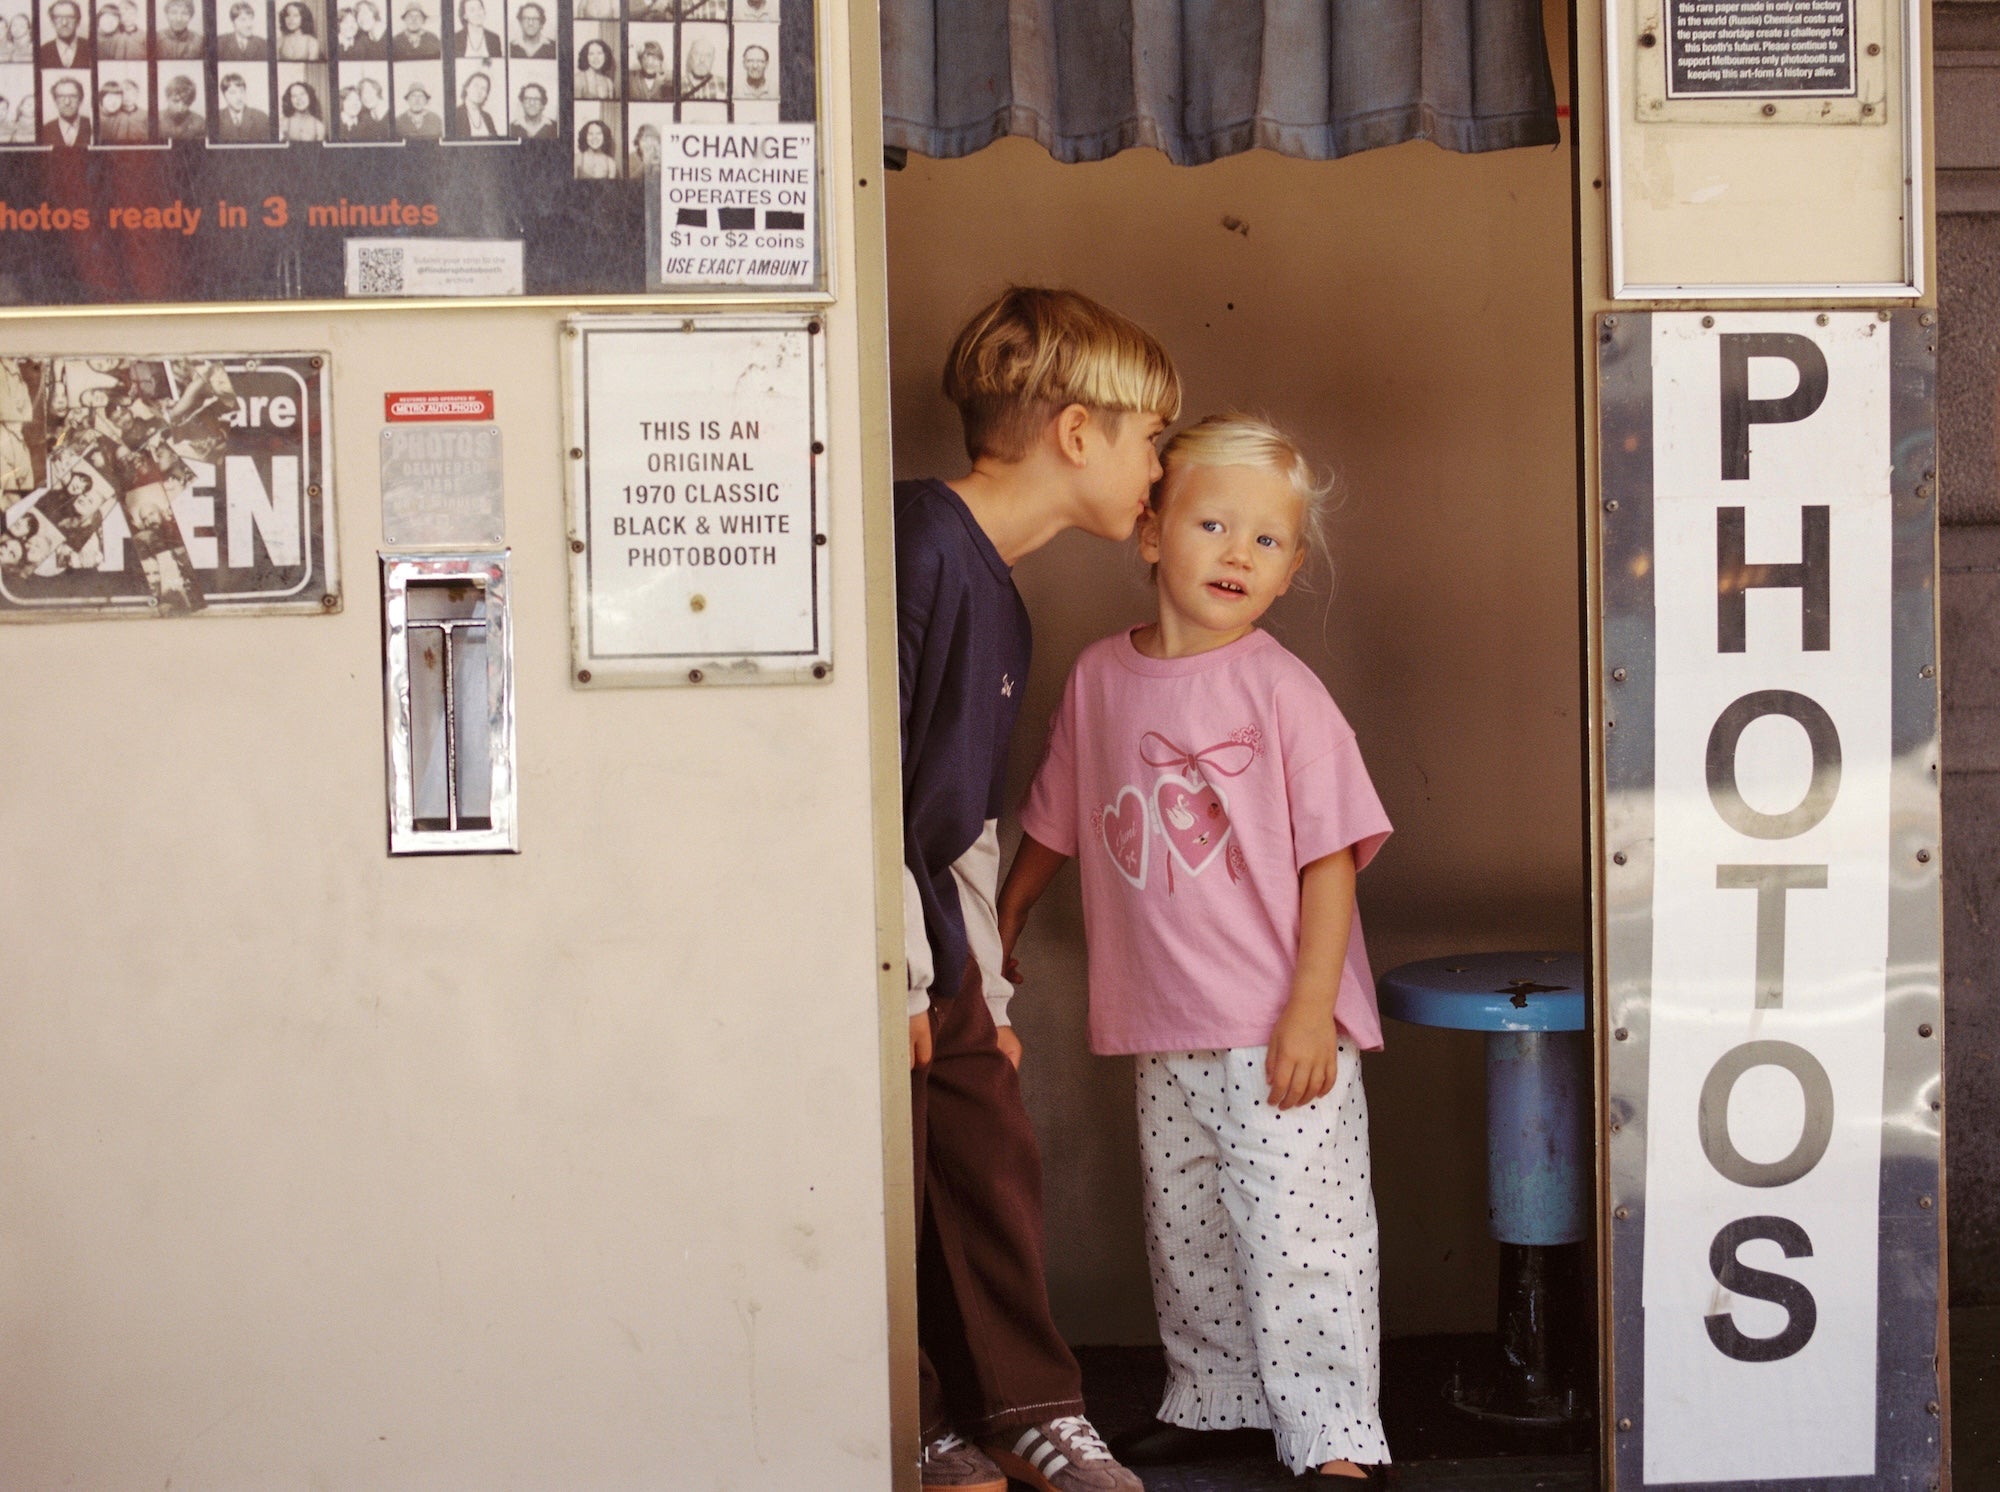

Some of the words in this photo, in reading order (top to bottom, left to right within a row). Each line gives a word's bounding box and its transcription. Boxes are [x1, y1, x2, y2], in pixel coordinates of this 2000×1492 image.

[1679, 2, 1695, 13] this
[1696, 4, 1713, 12] rare
[1715, 3, 1739, 14] paper
[1741, 2, 1764, 11] made
[1766, 2, 1774, 11] in
[1776, 2, 1793, 12] only
[1795, 2, 1810, 11] one
[1812, 1, 1841, 11] factory
[1678, 16, 1686, 26] in
[1688, 16, 1701, 26] the
[1703, 16, 1727, 26] world
[1764, 14, 1802, 24] Chemical
[1804, 14, 1826, 23] costs
[1828, 14, 1843, 23] and
[1677, 30, 1691, 40] the
[1692, 30, 1717, 41] paper
[1718, 29, 1755, 40] shortage
[1756, 28, 1782, 38] create
[1791, 28, 1831, 39] challenge
[1832, 27, 1844, 36] for
[1685, 42, 1701, 53] this
[1702, 42, 1733, 52] booth's
[1734, 41, 1761, 52] future.
[1763, 42, 1790, 51] Please
[1792, 41, 1827, 50] continue
[1829, 40, 1837, 50] to
[1678, 56, 1710, 68] support
[1712, 56, 1760, 66] Melbournes
[1762, 55, 1779, 66] only
[1781, 54, 1827, 66] photobooth
[1829, 53, 1845, 63] and
[1687, 69, 1720, 81] keeping
[1722, 69, 1738, 78] this
[1740, 69, 1774, 78] art-form
[1776, 68, 1782, 78] &
[1784, 67, 1813, 79] history
[1814, 67, 1836, 77] alive.
[668, 166, 712, 182] THIS
[719, 168, 808, 184] MACHINE
[669, 188, 771, 205] OPERATES
[778, 191, 806, 205] ON
[0, 202, 91, 231] hotos
[109, 200, 201, 235] ready
[218, 200, 248, 228] in
[263, 196, 288, 227] 3
[308, 198, 439, 227] minutes
[670, 231, 691, 247] $1
[700, 235, 719, 247] or
[725, 232, 748, 248] $2
[755, 233, 805, 248] coins
[667, 258, 695, 273] USE
[698, 258, 745, 274] EXACT
[747, 260, 809, 276] AMOUNT
[640, 421, 690, 440] THIS
[700, 421, 720, 440] IS
[730, 421, 759, 439] AN
[648, 452, 754, 472] ORIGINAL
[623, 485, 675, 504] 1970
[685, 483, 779, 503] CLASSIC
[614, 516, 686, 535] BLACK
[696, 516, 710, 534] &
[720, 515, 790, 534] WHITE
[628, 547, 776, 567] PHOTOBOOTH
[1697, 332, 1843, 1363] PHOTOS
